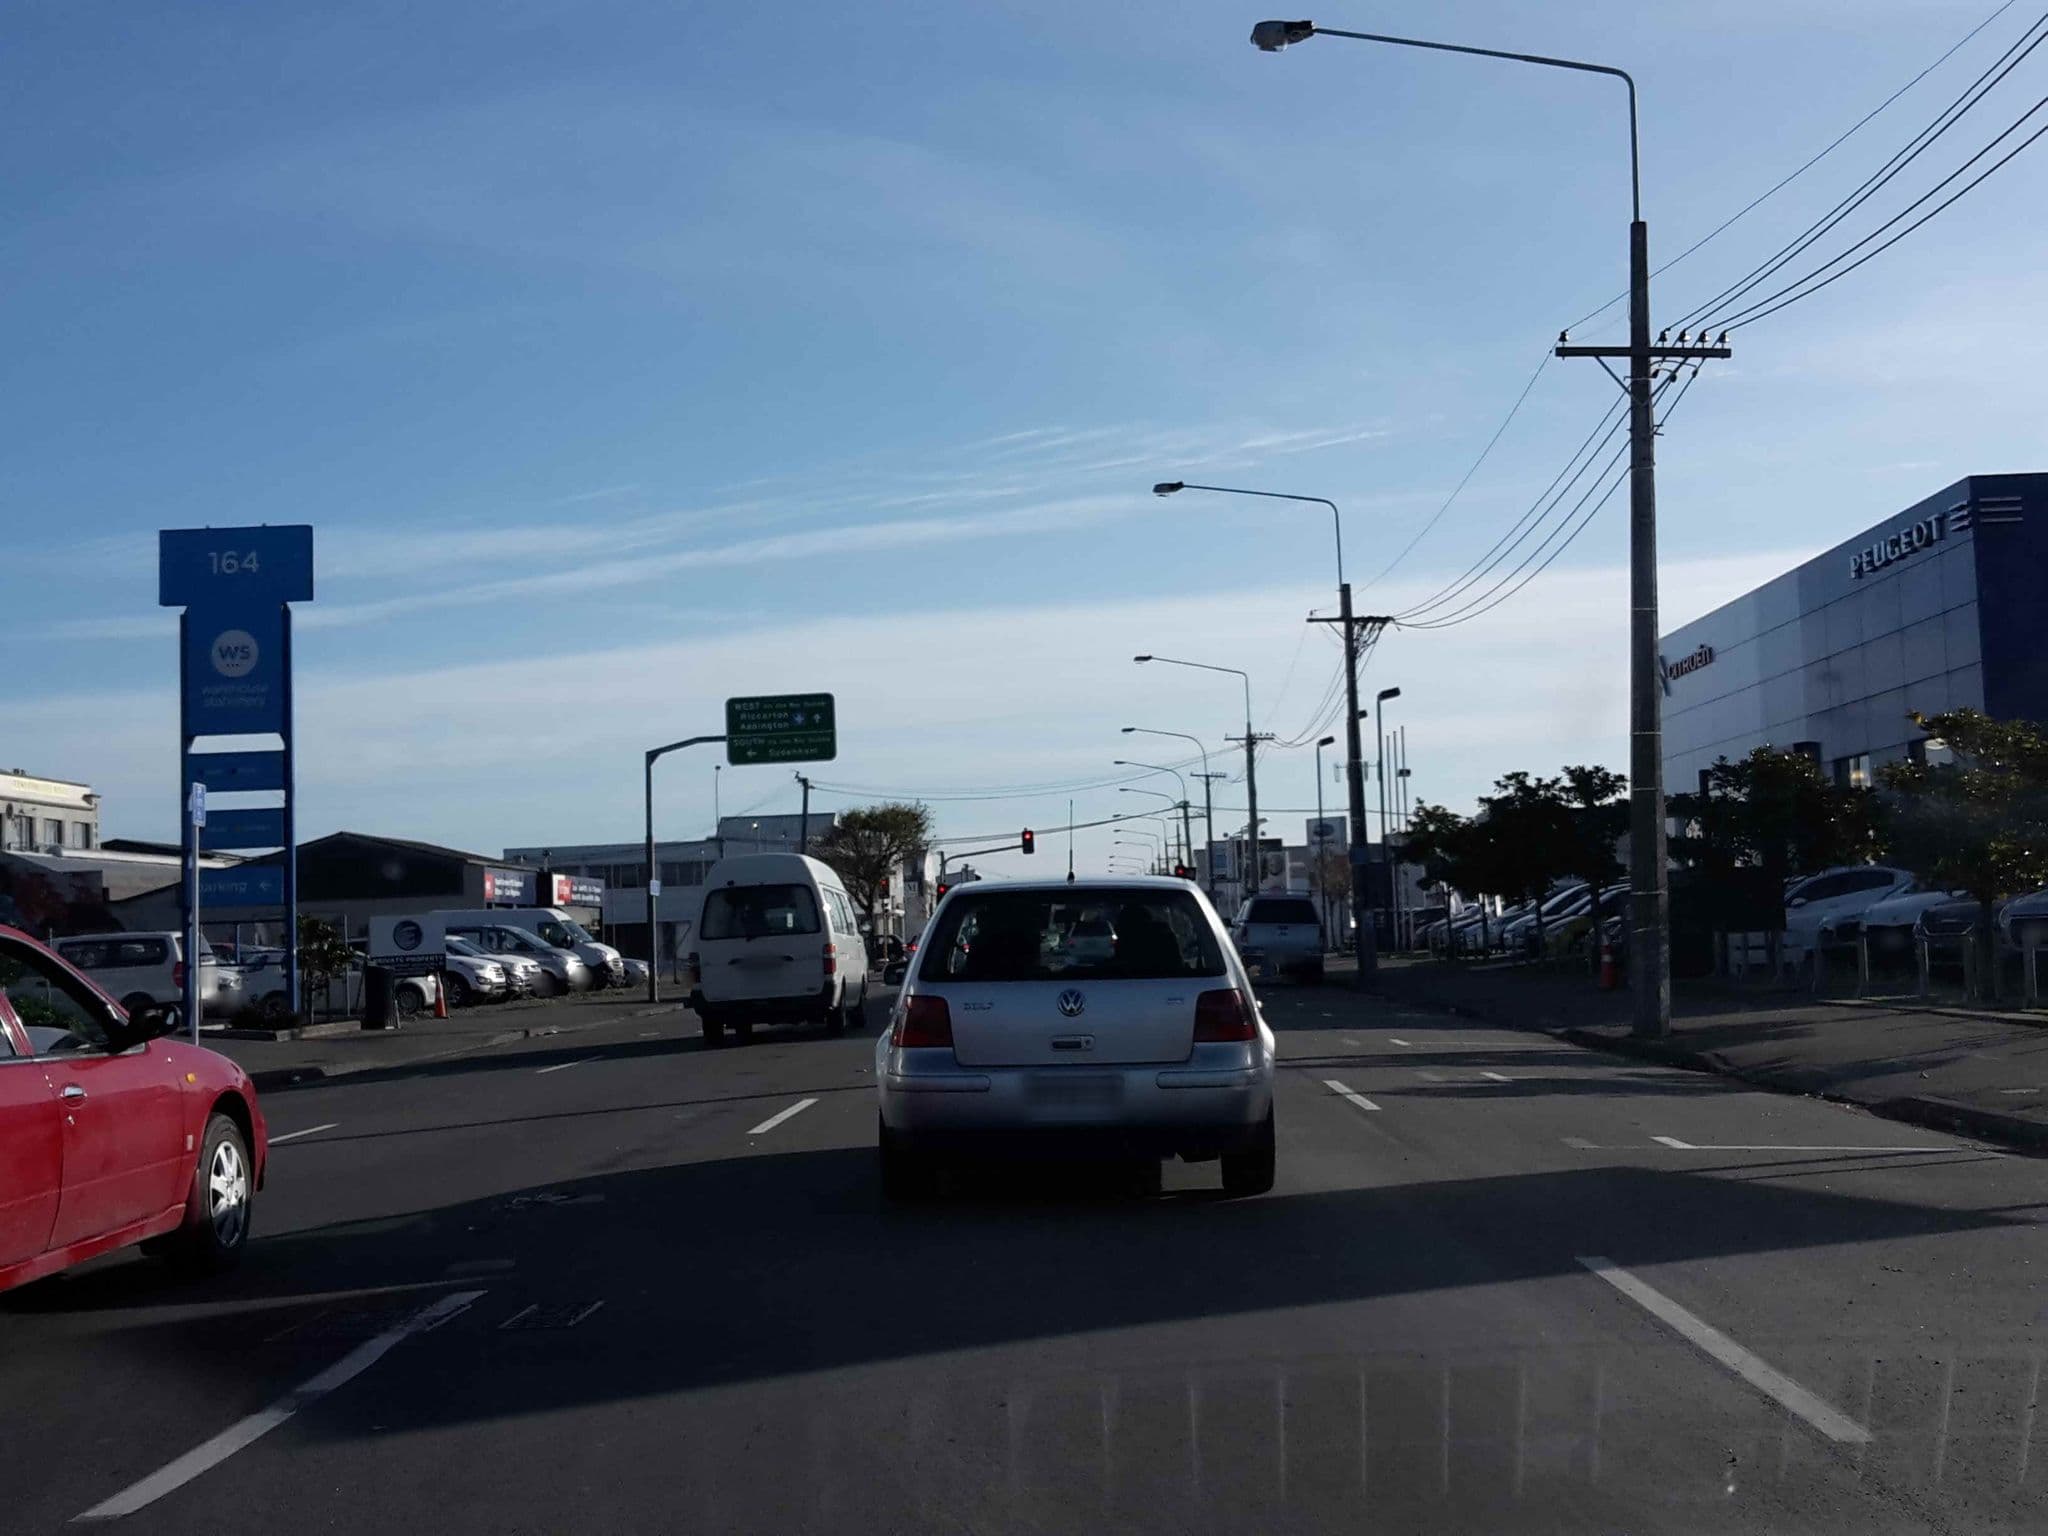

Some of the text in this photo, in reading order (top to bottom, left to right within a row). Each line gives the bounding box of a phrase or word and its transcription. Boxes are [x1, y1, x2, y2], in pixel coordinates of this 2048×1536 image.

[1849, 517, 1945, 578] PEUGEOT
[208, 549, 260, 575] 164
[218, 644, 250, 660] WS
